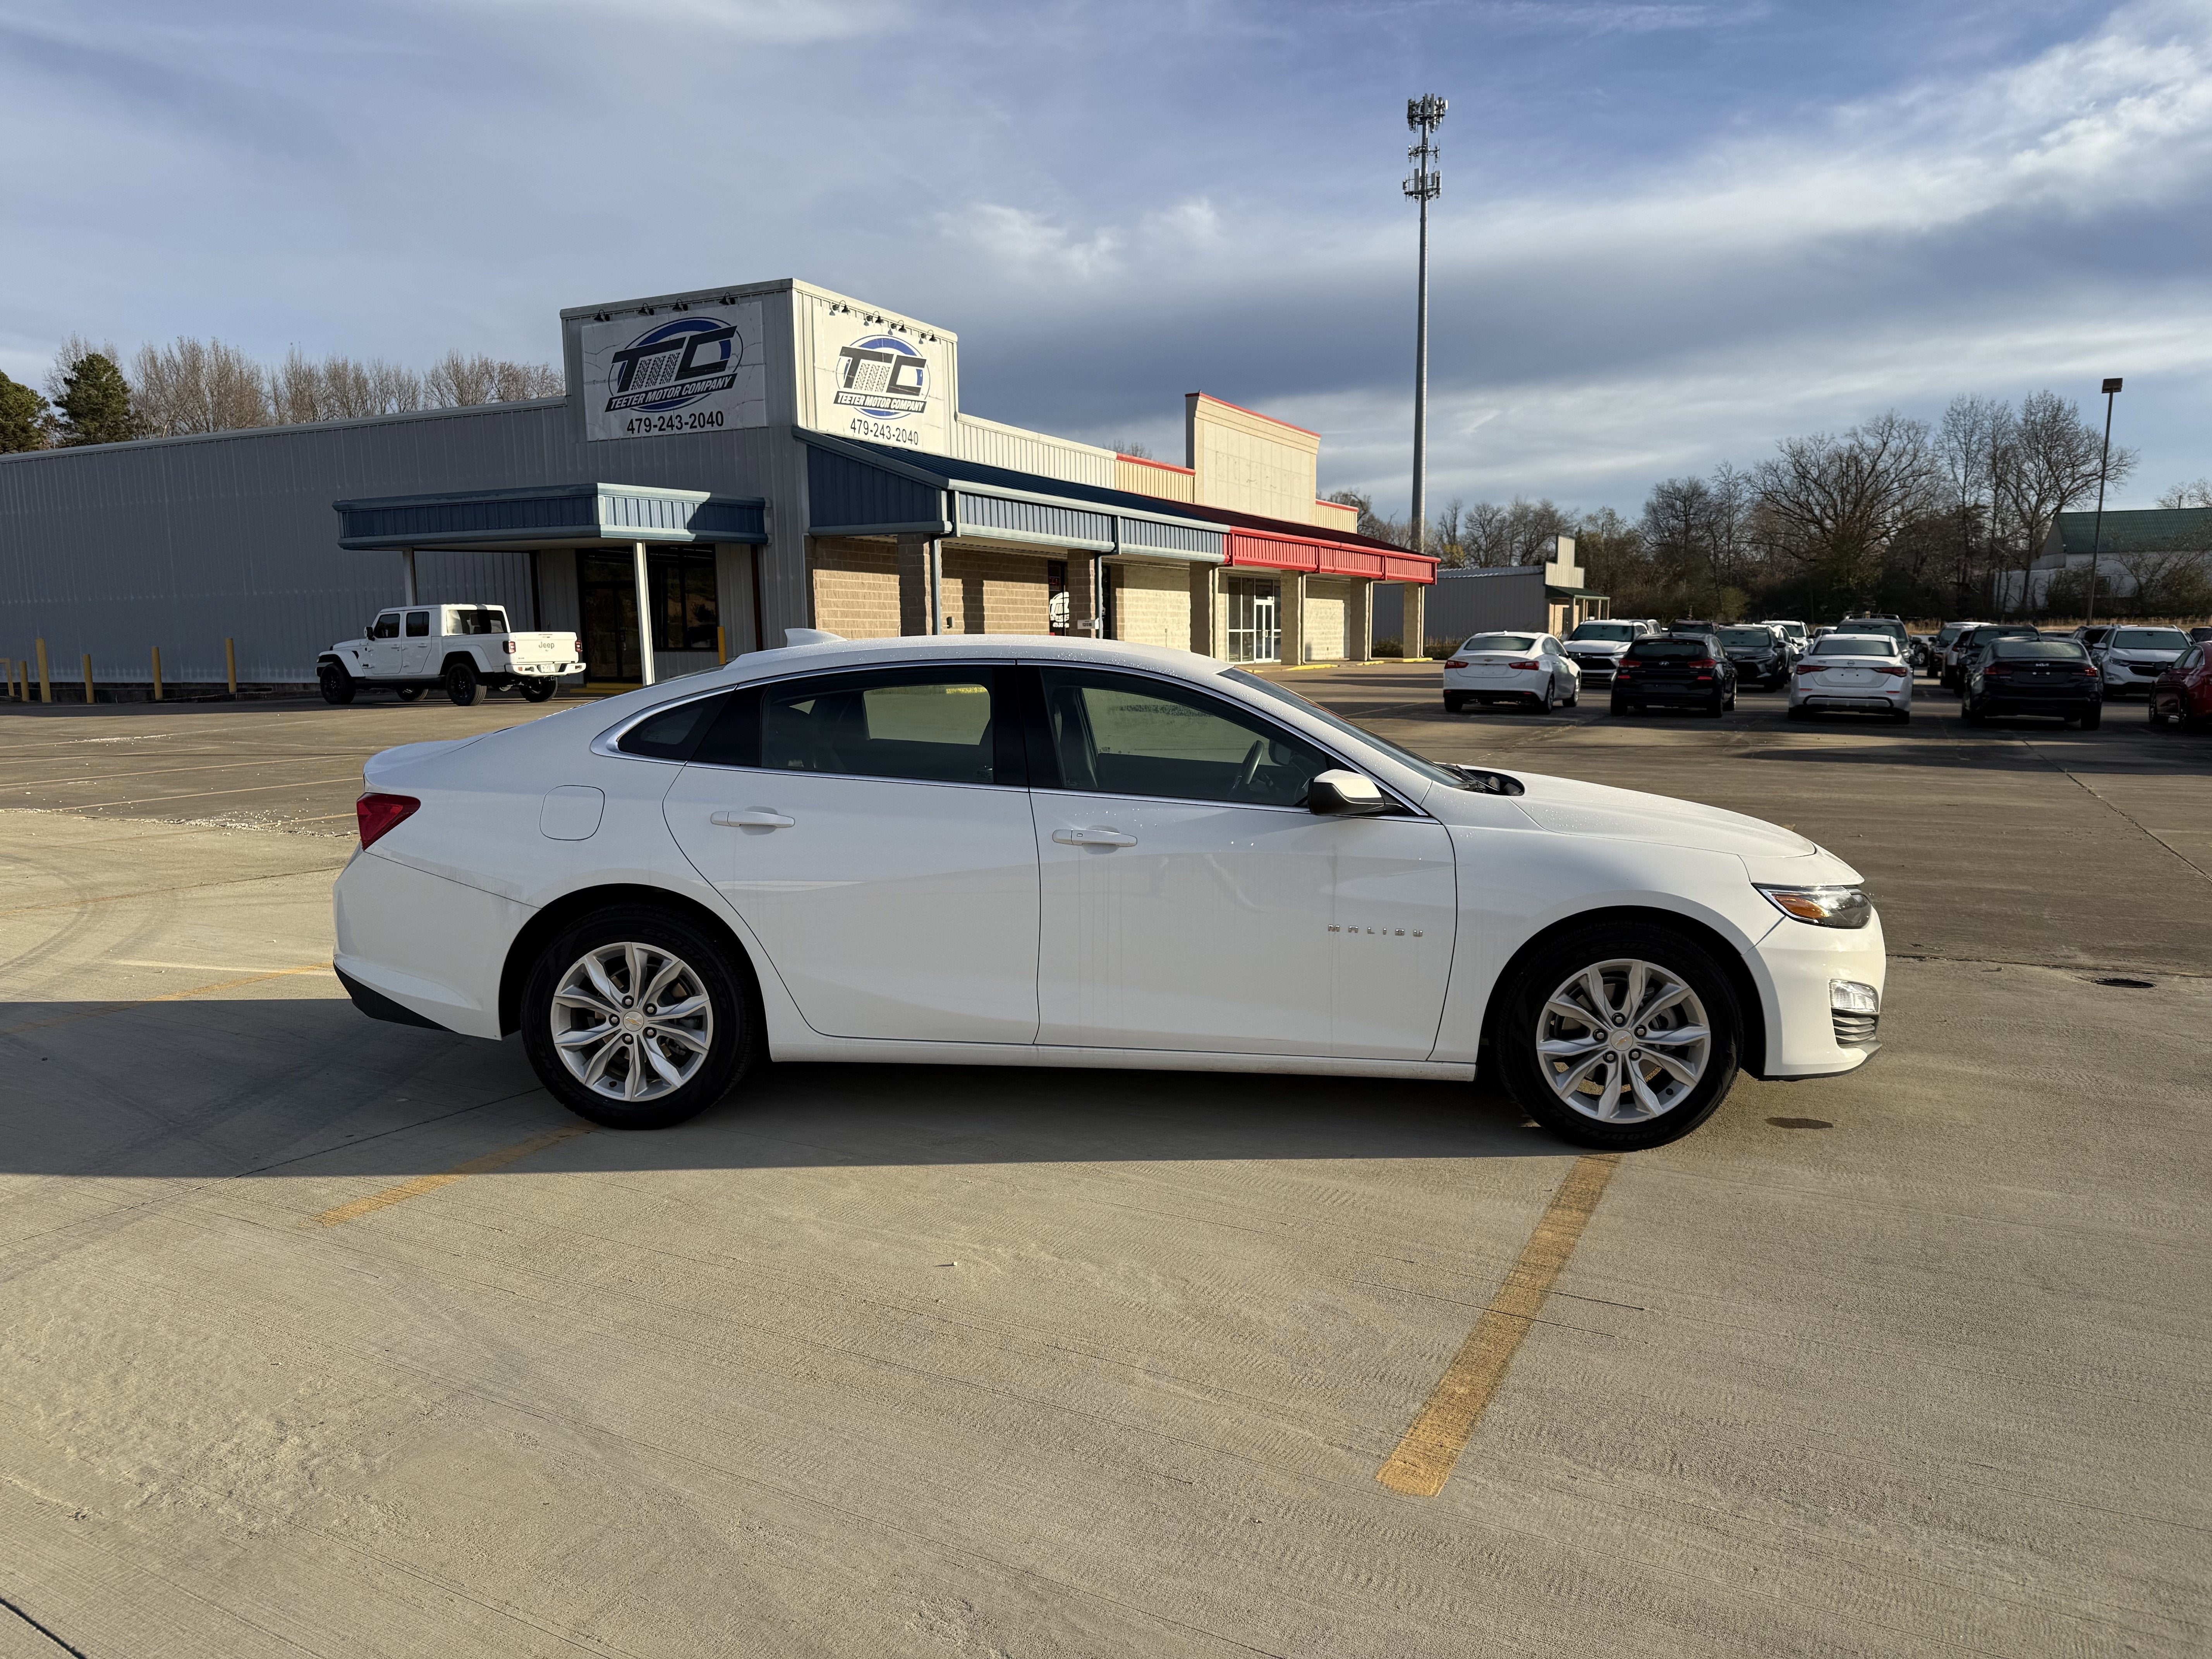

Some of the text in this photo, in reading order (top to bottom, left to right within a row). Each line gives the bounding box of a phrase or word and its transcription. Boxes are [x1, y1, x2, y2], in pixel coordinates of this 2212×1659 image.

[610, 375, 732, 410] TEETER MOTOR COMPANY
[838, 393, 924, 412] TEETER MOTOR COMPANY
[627, 410, 724, 434] 479-243-2040
[850, 417, 919, 445] 479-243-2040
[1328, 924, 1423, 937] MALIBU
